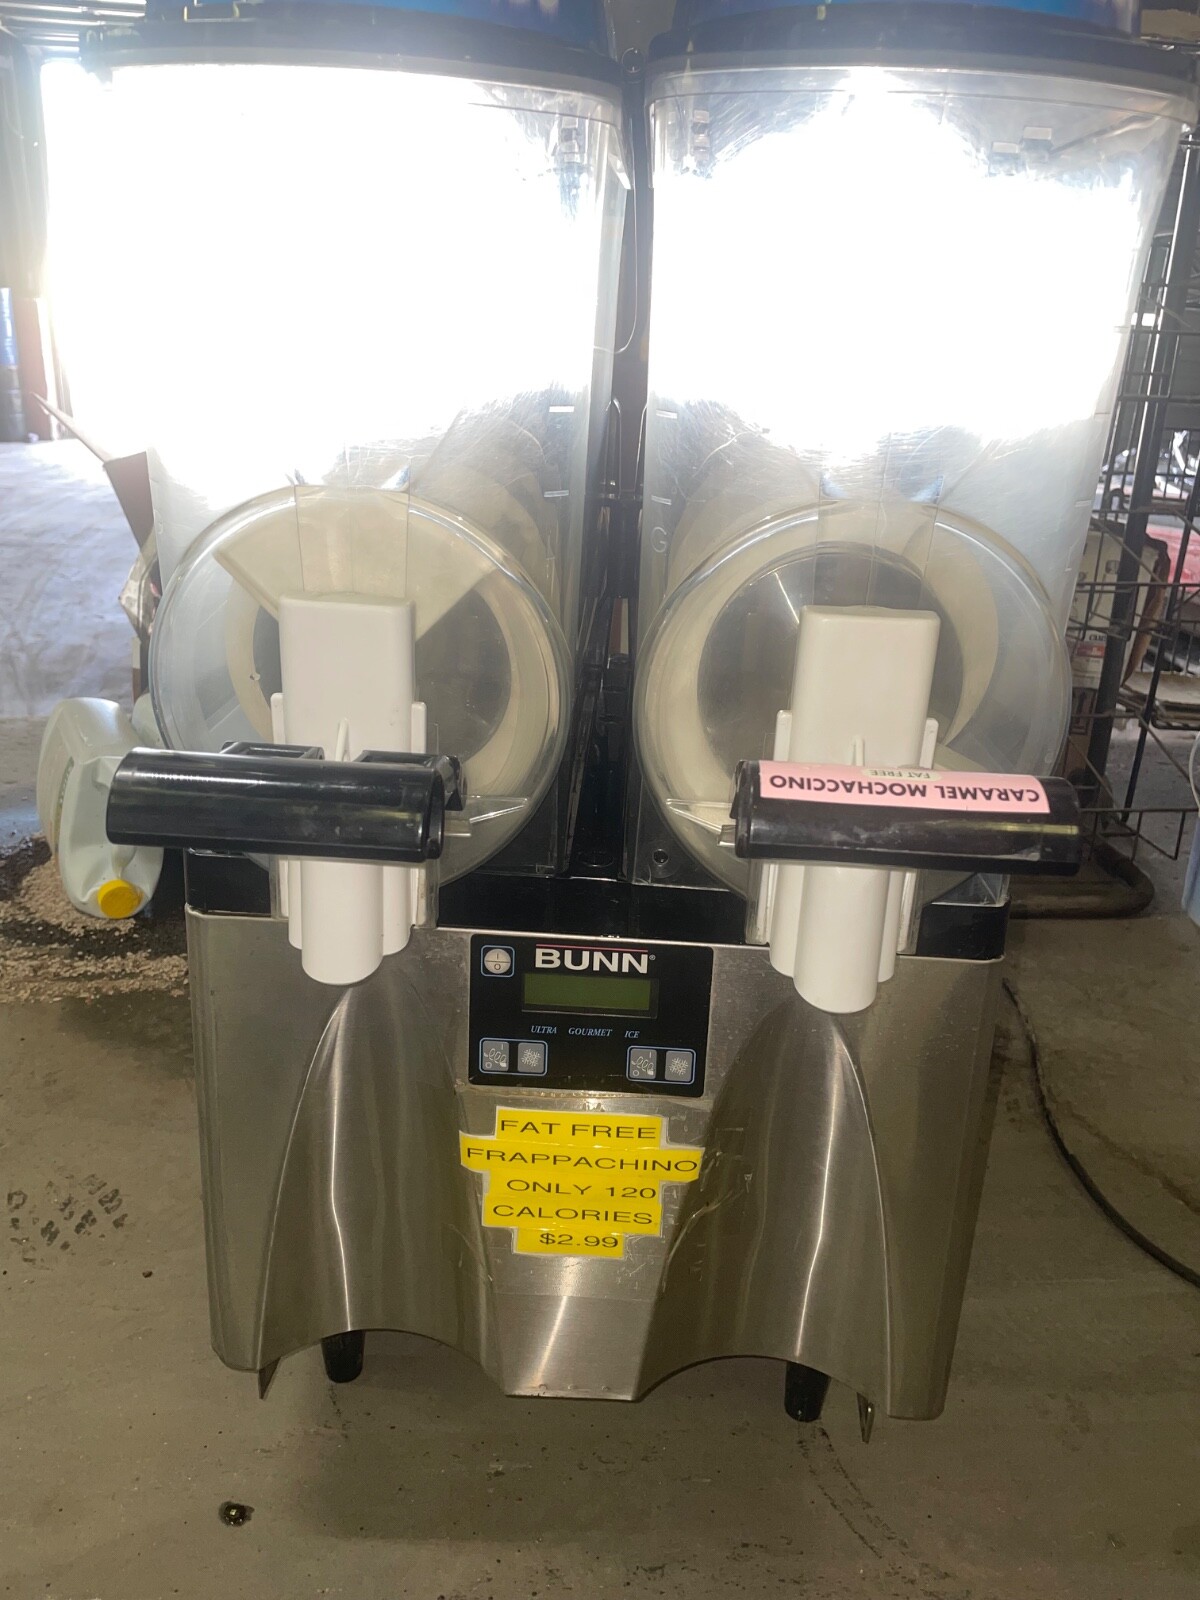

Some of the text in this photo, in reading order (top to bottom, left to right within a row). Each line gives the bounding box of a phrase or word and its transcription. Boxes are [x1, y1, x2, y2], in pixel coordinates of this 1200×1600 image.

[769, 775, 1040, 802] CARAMEL MOCHACCINO
[530, 1025, 640, 1039] ULTRA GOURMET ICE
[501, 1119, 657, 1139] FAT FREE
[467, 1147, 698, 1172] FRAPPACHINO
[506, 1179, 657, 1199] ONLY 120
[492, 1204, 653, 1225] CALORIES
[539, 1232, 619, 1248] $2.99
